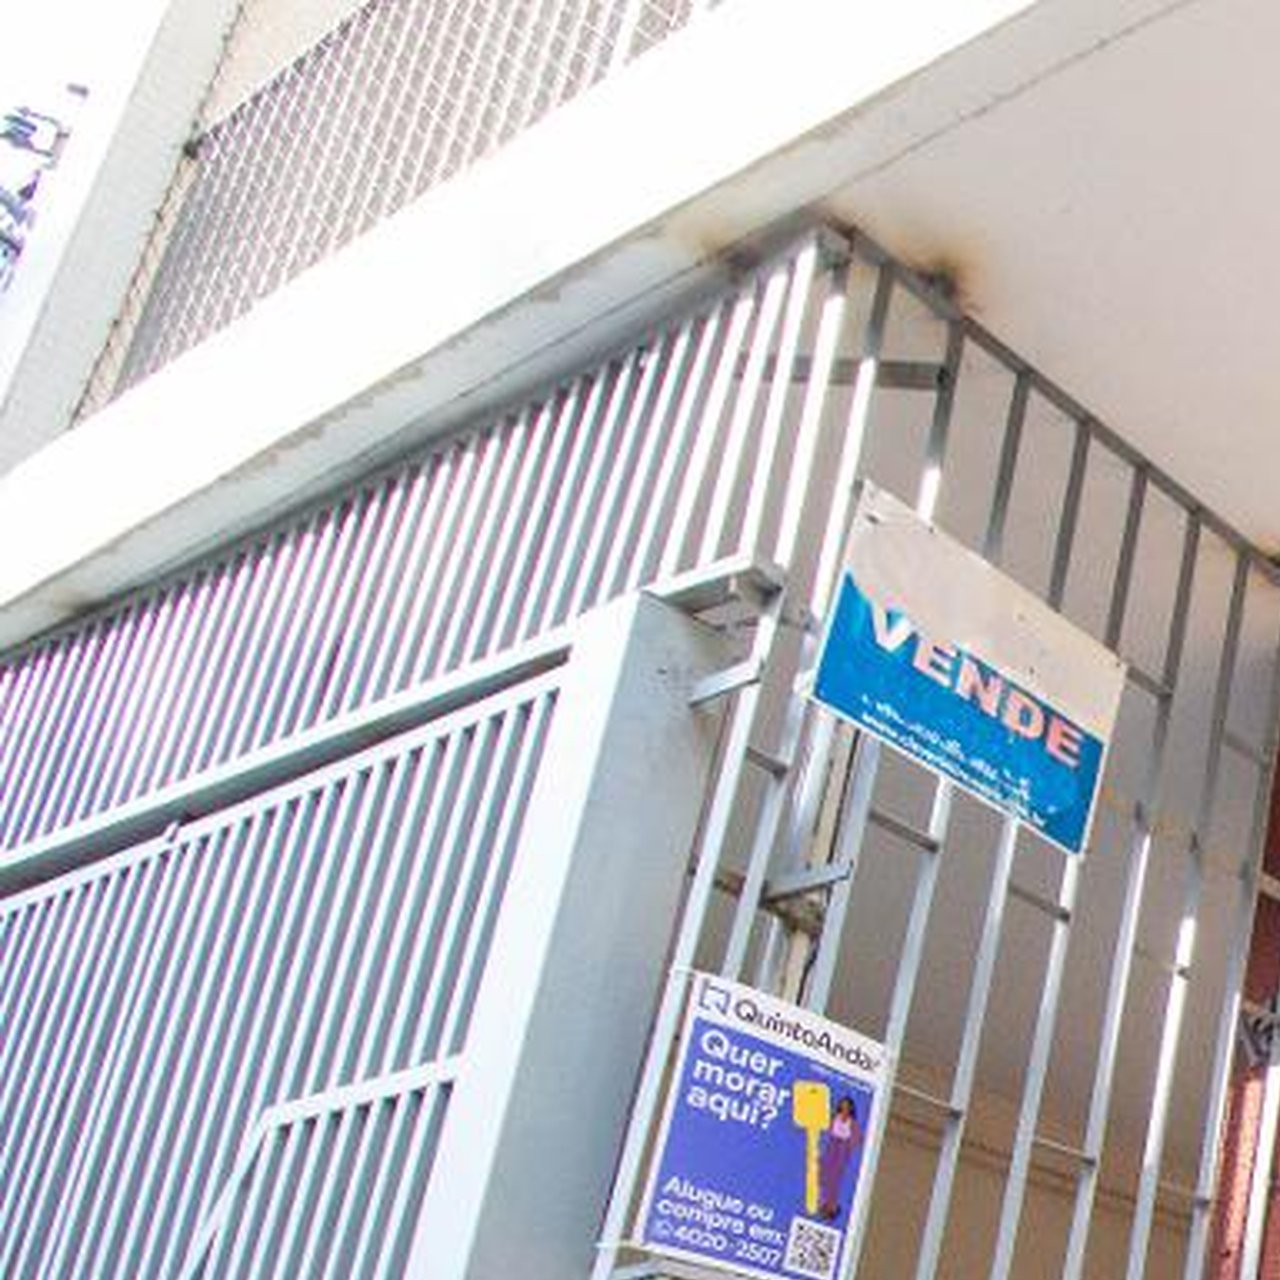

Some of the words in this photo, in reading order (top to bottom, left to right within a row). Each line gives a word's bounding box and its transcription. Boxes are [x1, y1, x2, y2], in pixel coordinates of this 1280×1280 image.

[868, 598, 1084, 768] VENDE
[701, 1029, 783, 1077] Quer
[693, 1059, 790, 1107] morar
[687, 1086, 778, 1130] aqui?
[657, 1199, 745, 1234] compre
[662, 1176, 744, 1214] Alugue
[747, 1204, 774, 1221] ou
